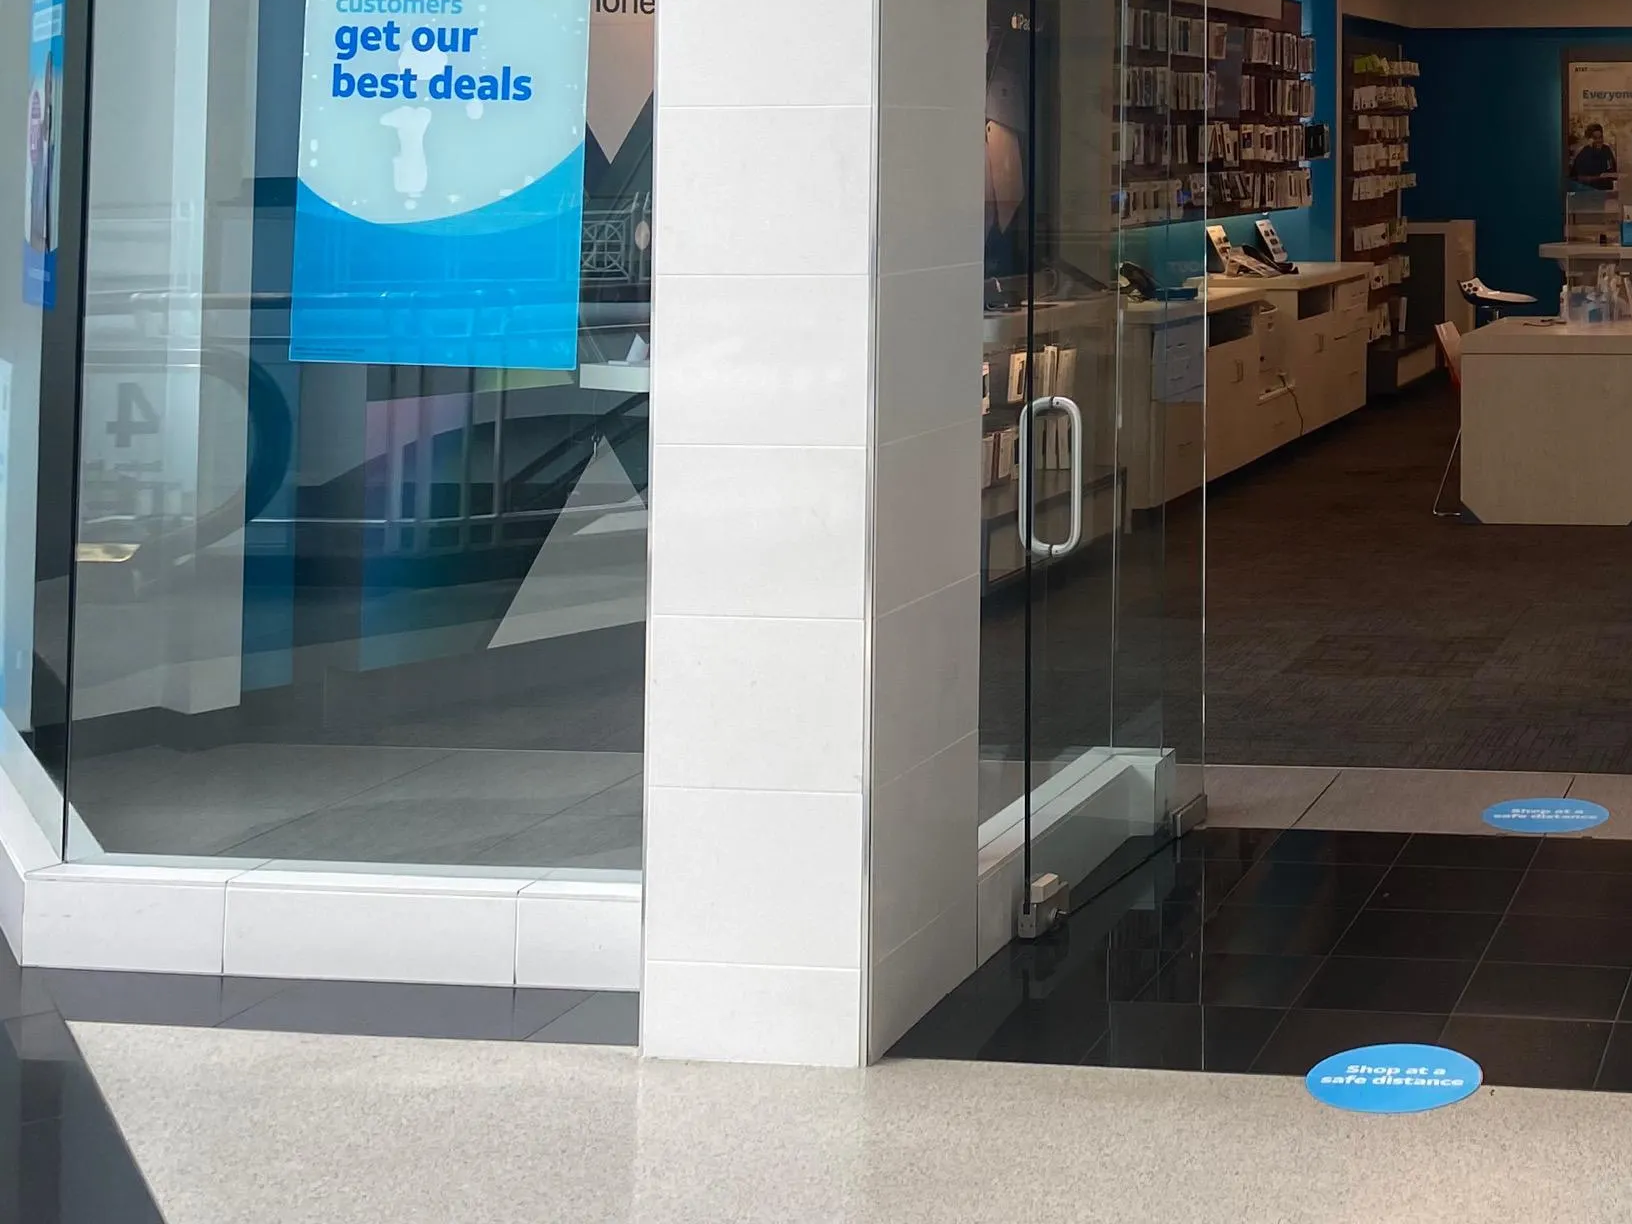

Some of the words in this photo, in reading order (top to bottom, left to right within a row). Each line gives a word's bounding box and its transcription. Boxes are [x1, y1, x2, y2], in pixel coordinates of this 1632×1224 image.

[334, 21, 401, 60] get
[411, 25, 479, 54] our
[331, 63, 418, 100] best
[428, 66, 533, 102] deals
[1511, 807, 1547, 817] Shop
[1530, 812, 1599, 820] distance
[1345, 1064, 1400, 1077] Shop
[1405, 1065, 1429, 1075] at
[1433, 1067, 1447, 1076] a
[1320, 1074, 1368, 1085] safe
[1372, 1075, 1465, 1087] distance
